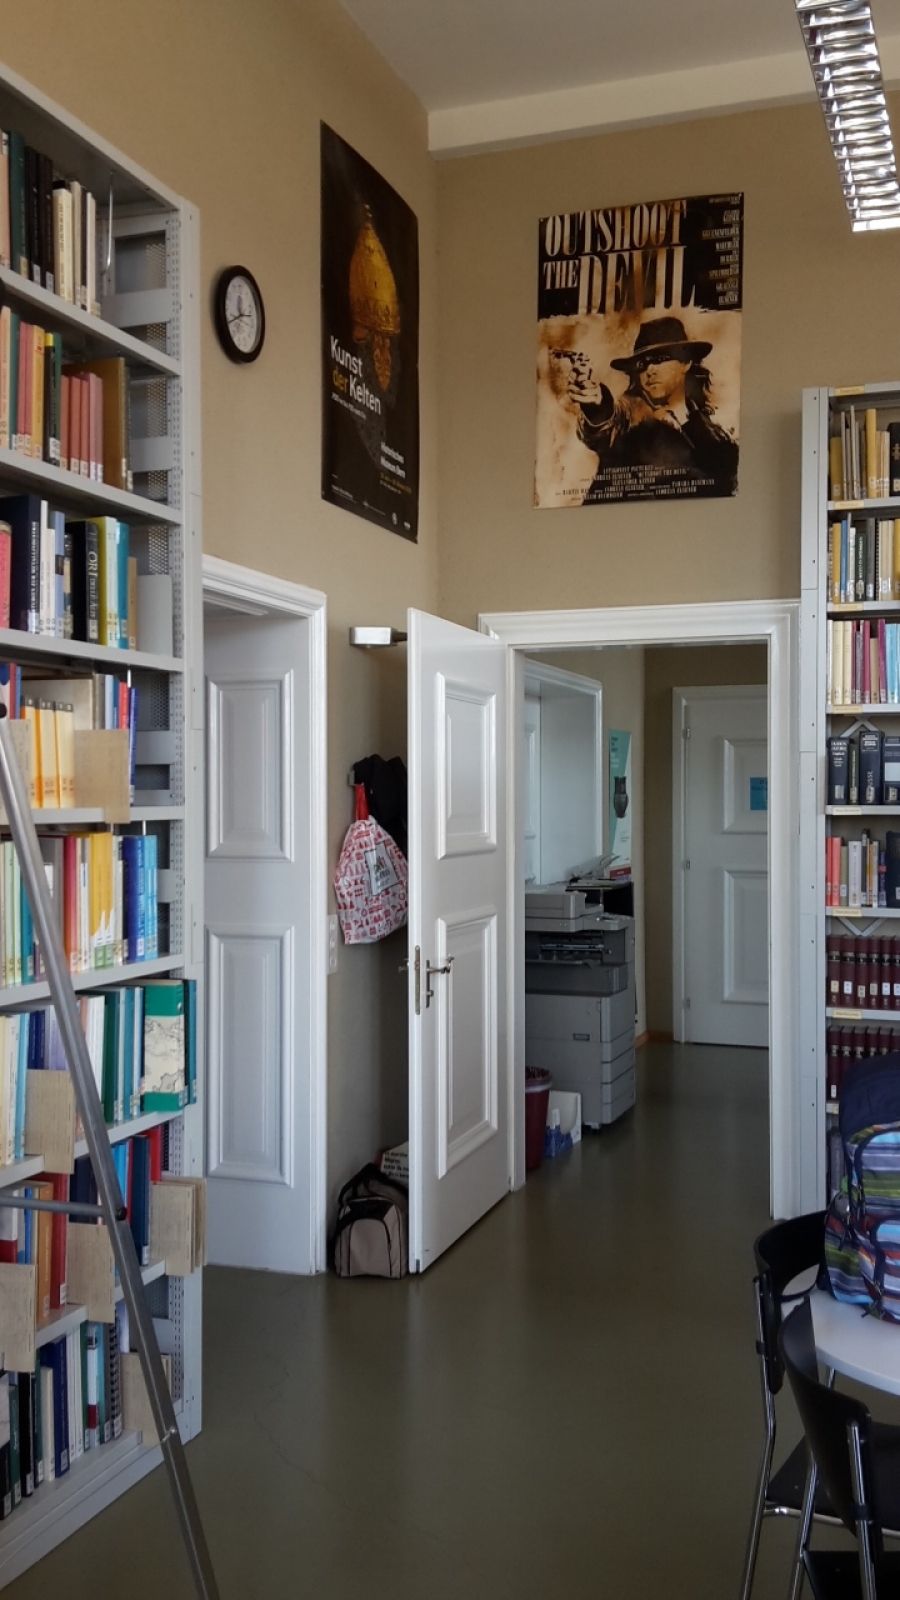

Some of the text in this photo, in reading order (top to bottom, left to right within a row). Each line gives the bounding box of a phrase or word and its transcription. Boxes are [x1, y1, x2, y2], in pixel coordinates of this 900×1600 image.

[545, 199, 687, 256] OUTSHOOT
[544, 245, 697, 315] THE DEVIL
[331, 335, 362, 378] Kunst
[333, 368, 348, 393] der
[350, 374, 381, 415] Kelten
